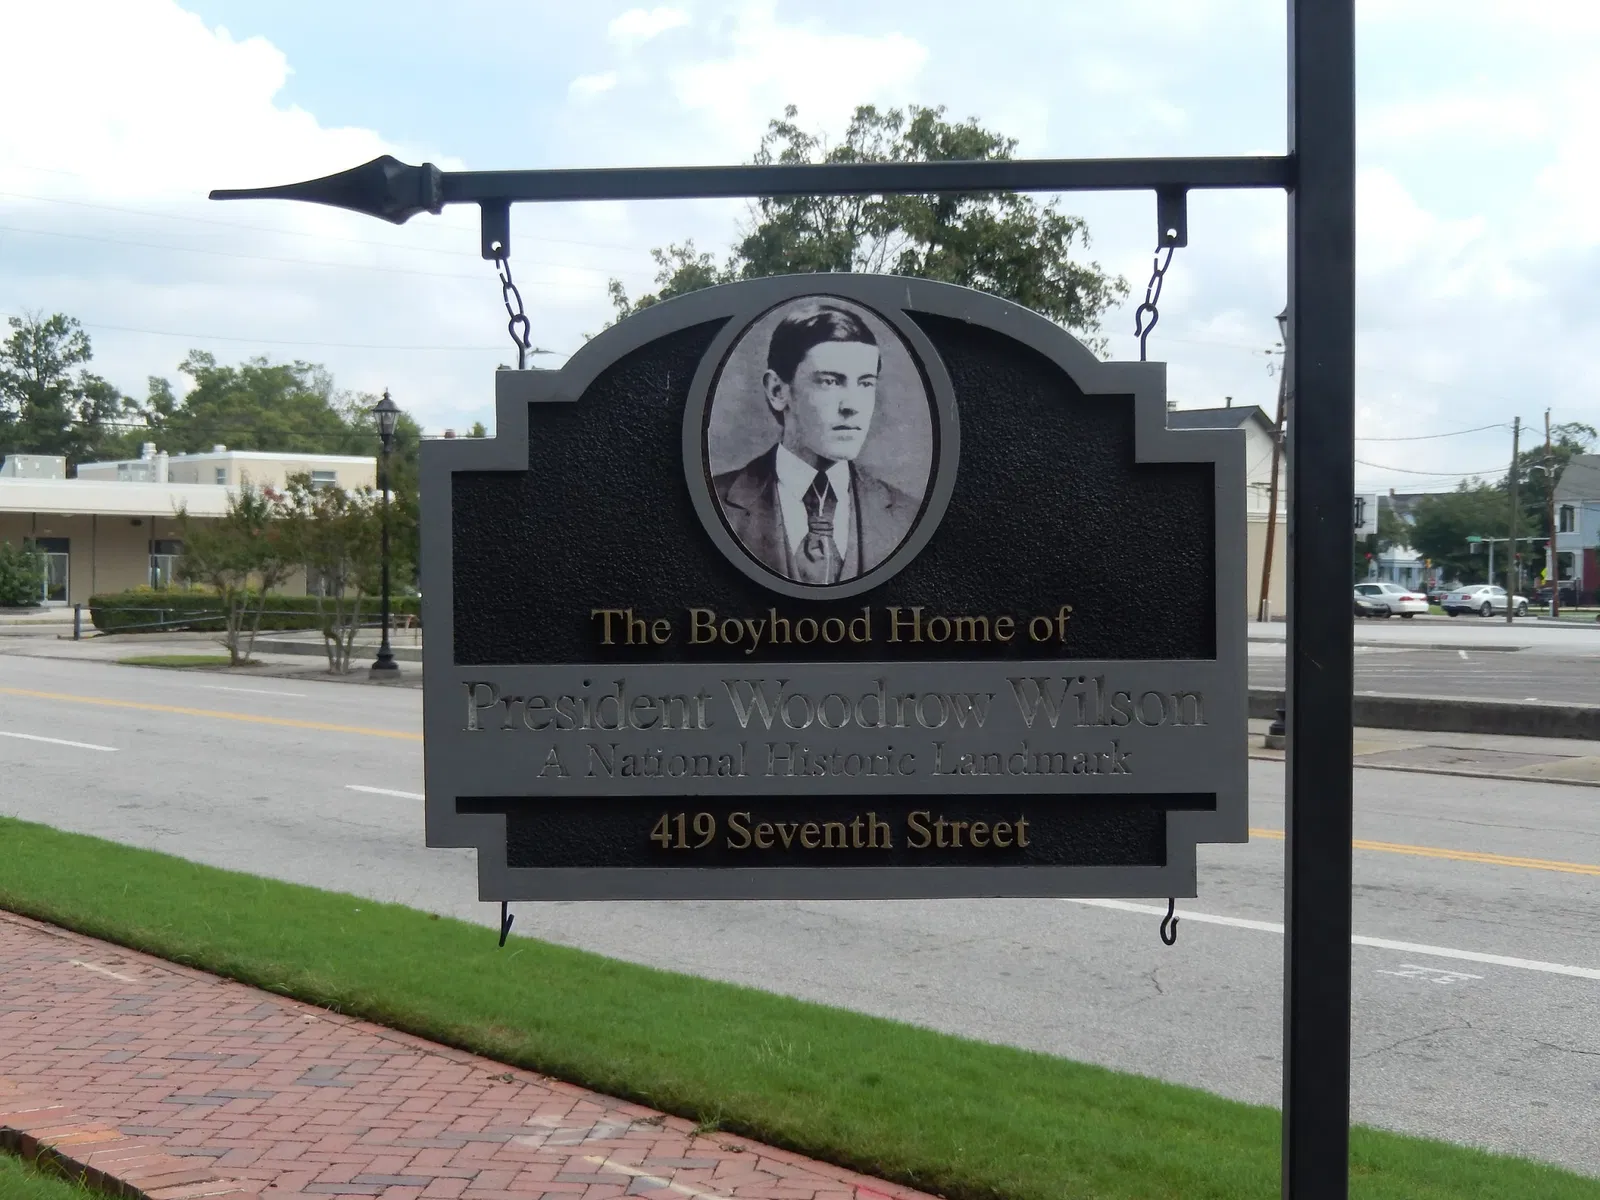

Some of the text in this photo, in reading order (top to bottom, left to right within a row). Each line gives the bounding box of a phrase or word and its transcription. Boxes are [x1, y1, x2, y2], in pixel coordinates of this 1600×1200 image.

[591, 605, 1073, 654] The Boyhood Home of
[461, 674, 1208, 731] President Woodrow Wilson
[536, 739, 1133, 778] A National Historic Landmark
[650, 811, 1030, 849] 419 Seventh Street
